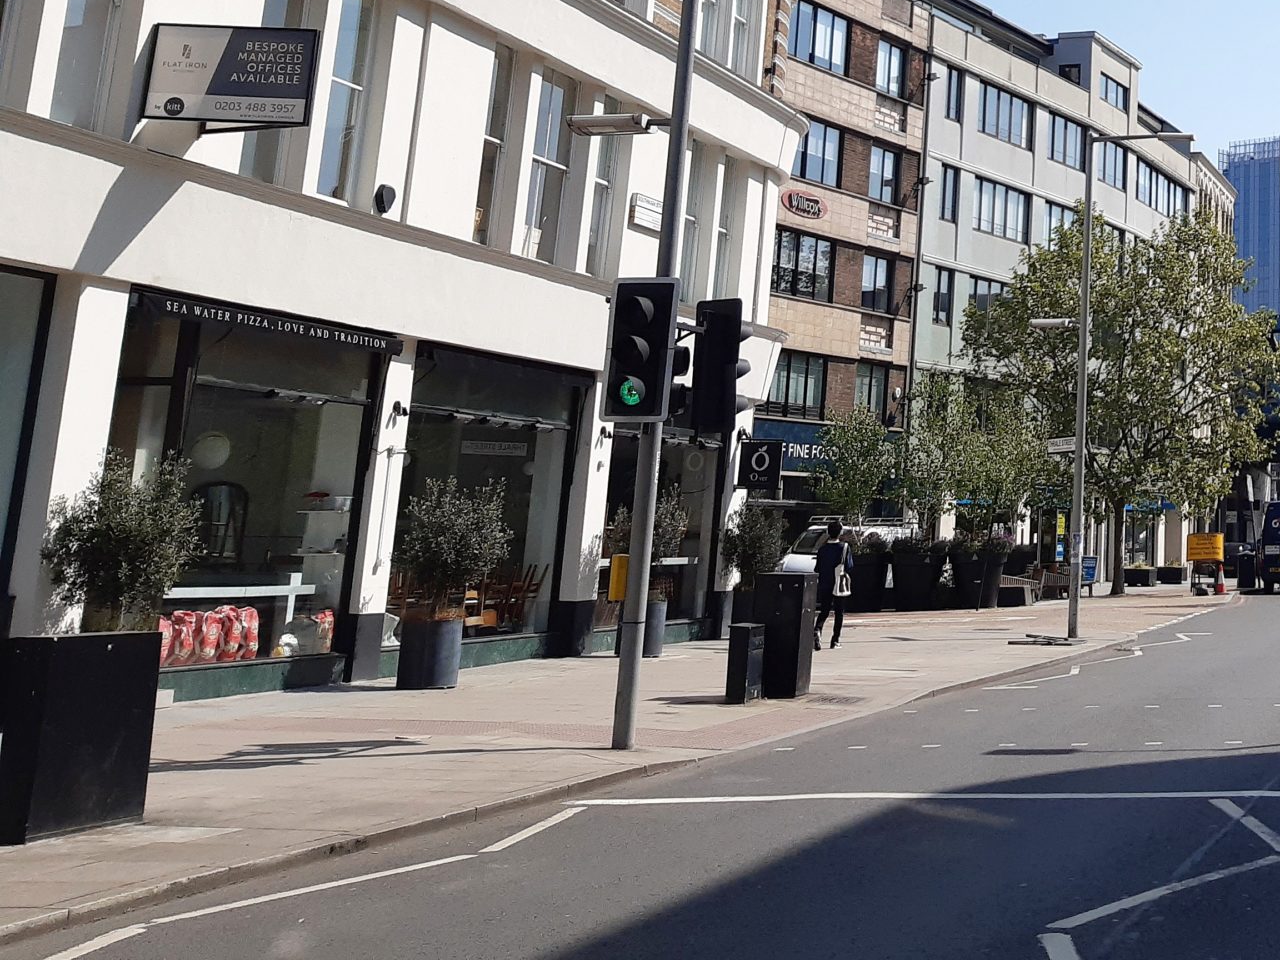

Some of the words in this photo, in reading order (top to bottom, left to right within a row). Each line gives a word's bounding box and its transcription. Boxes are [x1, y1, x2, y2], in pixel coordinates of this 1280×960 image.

[245, 41, 304, 53] BESPOKE
[237, 52, 303, 63] MANAGED
[246, 62, 302, 74] OFFICES
[229, 73, 301, 85] AVAILABLE
[166, 102, 181, 111] kitt
[214, 101, 242, 111] 0203
[245, 102, 266, 112] 488
[270, 103, 296, 114] 3957
[166, 301, 188, 314] SEA
[193, 306, 230, 322] WATER
[278, 320, 305, 335] LOVE
[308, 328, 329, 339] AND
[334, 331, 387, 349] TRADITION
[788, 443, 810, 458] FINE
